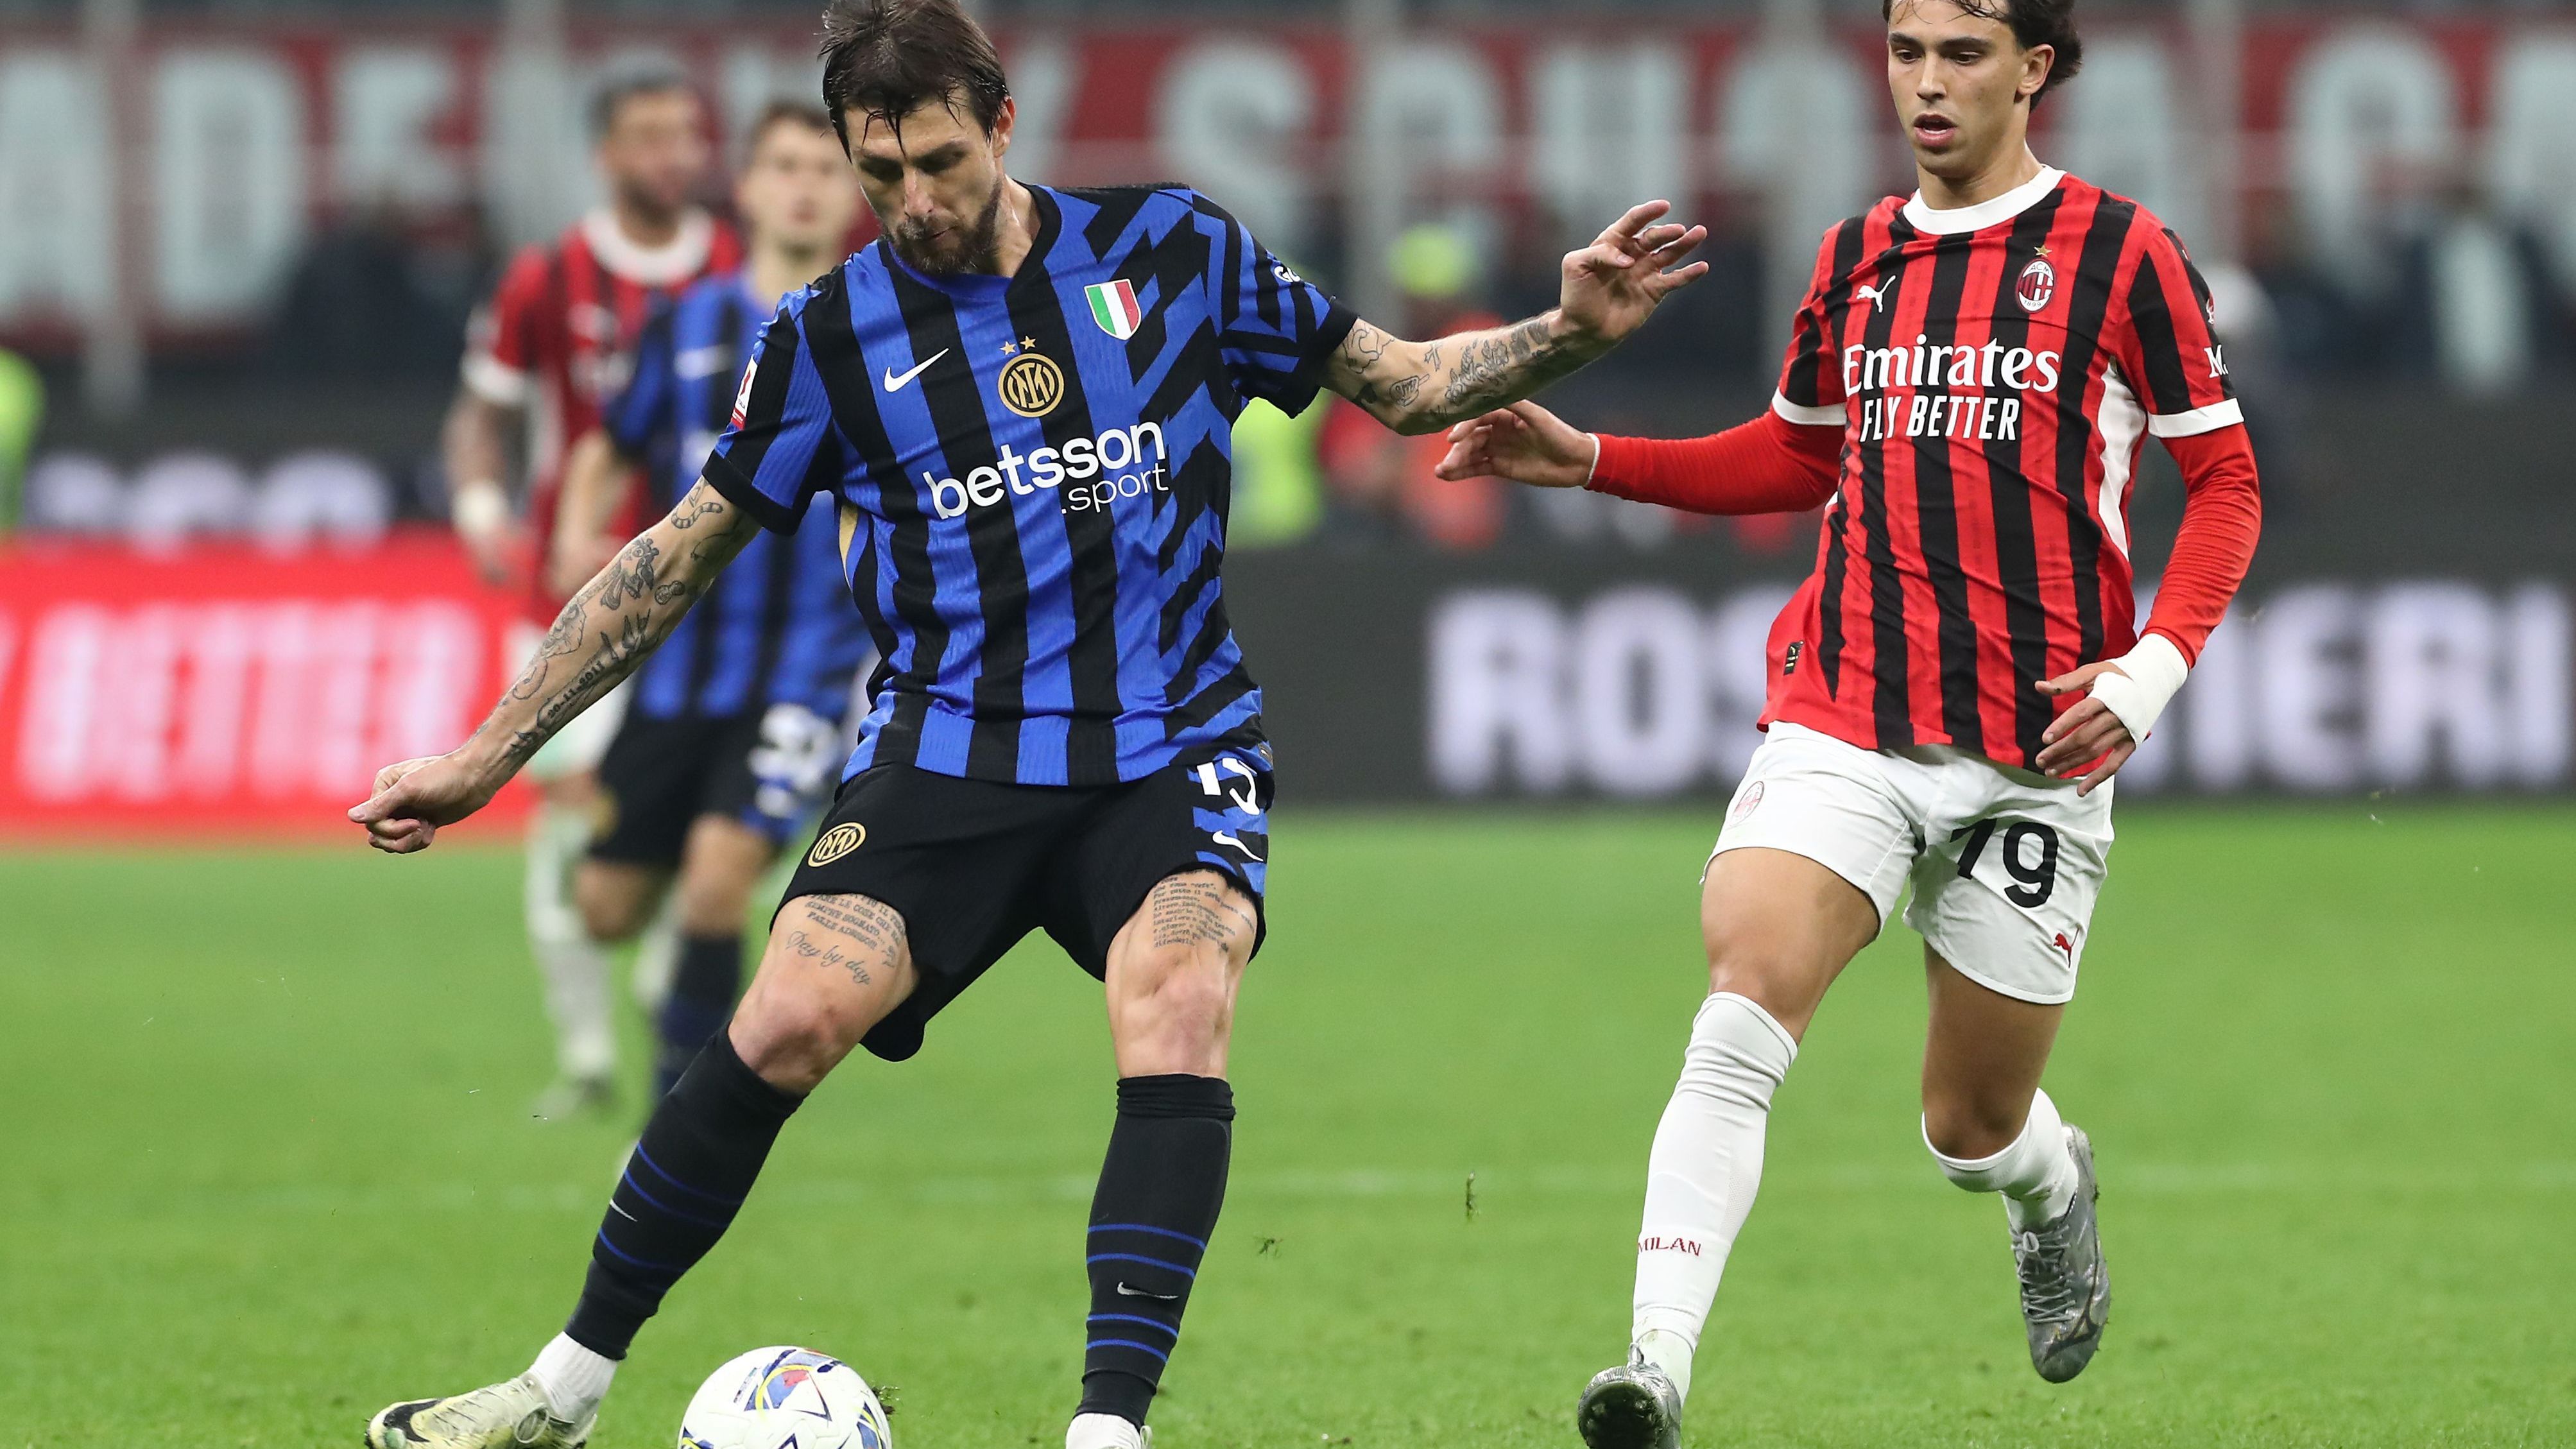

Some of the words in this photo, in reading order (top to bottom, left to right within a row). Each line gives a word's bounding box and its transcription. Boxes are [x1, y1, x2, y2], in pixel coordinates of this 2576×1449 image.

[2023, 299, 2042, 307] 1899
[1843, 334, 2059, 393] Emirates
[1860, 395, 1902, 442] FLY
[1907, 395, 2020, 442] BETTER
[923, 422, 1165, 519] betsson
[1061, 463, 1169, 513] .sport
[1950, 818, 2059, 909] 19
[821, 945, 845, 967] by
[1638, 1237, 1701, 1257] MILAN
